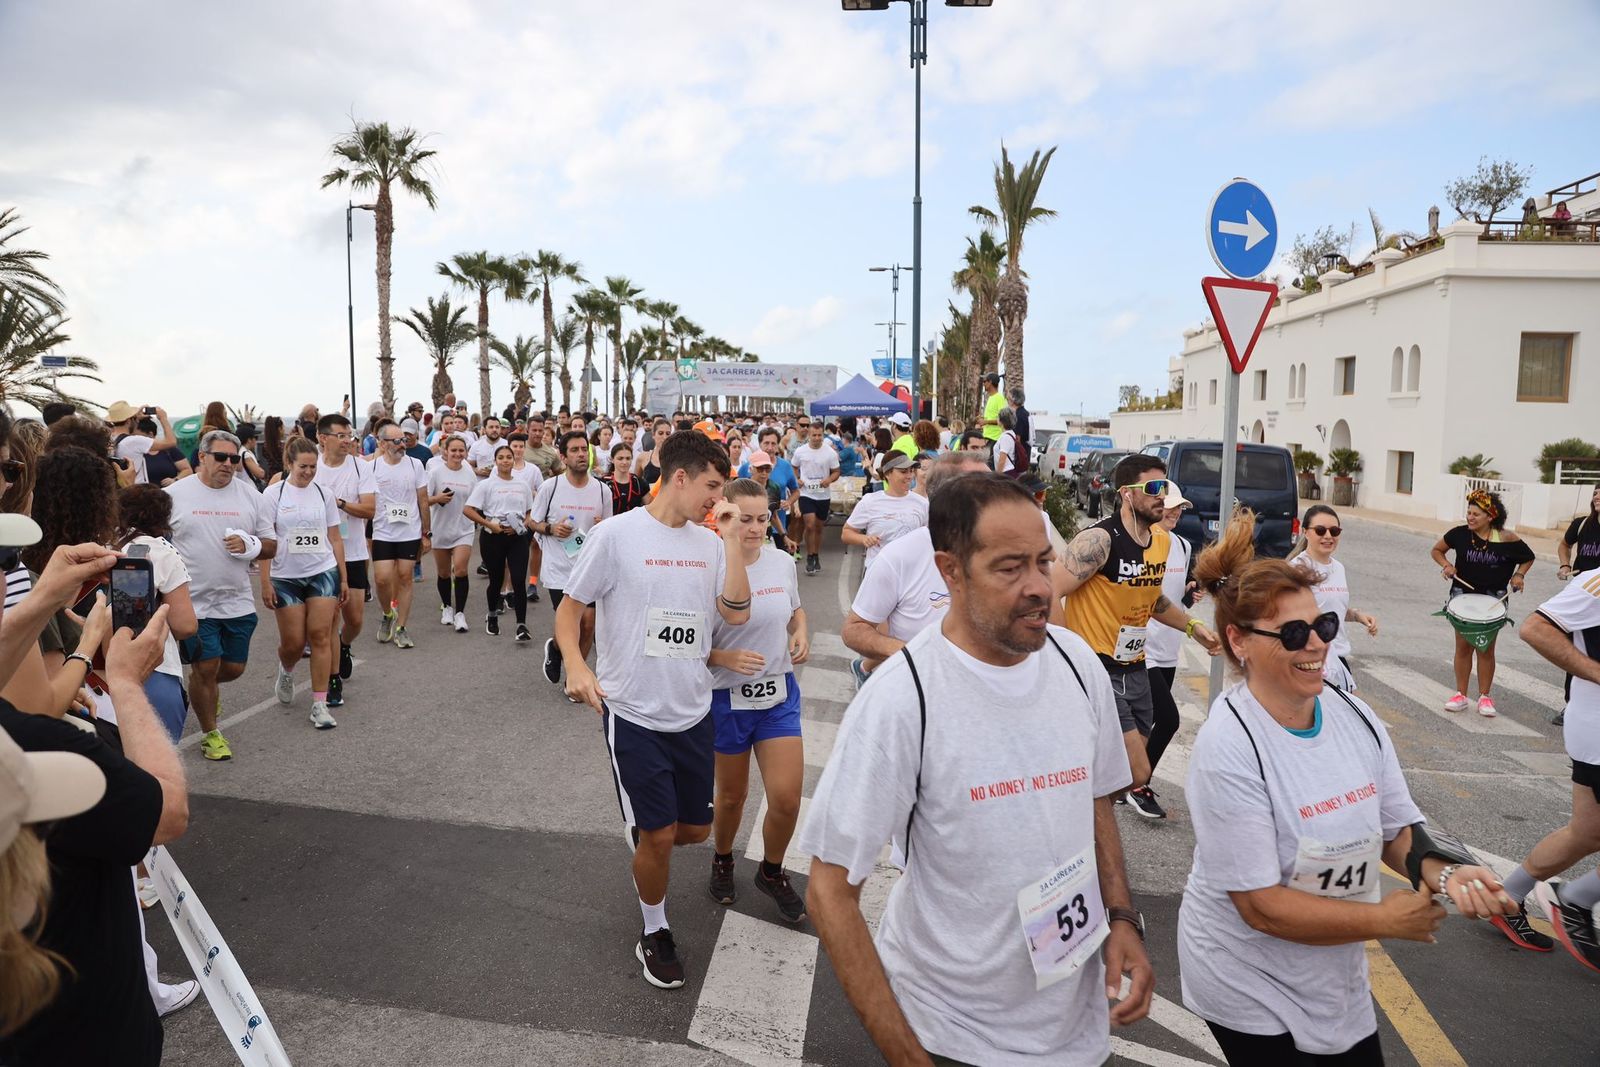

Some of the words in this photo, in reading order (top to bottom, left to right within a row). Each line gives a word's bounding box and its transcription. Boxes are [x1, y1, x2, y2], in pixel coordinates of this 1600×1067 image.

[706, 367, 718, 375] 3A
[720, 368, 761, 376] CARRERA
[392, 508, 408, 516] 925
[295, 535, 319, 546] 238
[658, 625, 696, 645] 408
[741, 680, 777, 698] 625
[970, 785, 986, 802] NO
[1032, 775, 1046, 791] NO
[1299, 806, 1314, 819] NO
[1345, 791, 1357, 804] NO
[1040, 881, 1049, 893] 3A
[1049, 863, 1077, 887] CARRERA
[1317, 861, 1368, 890] 141
[1056, 893, 1089, 943] 53
